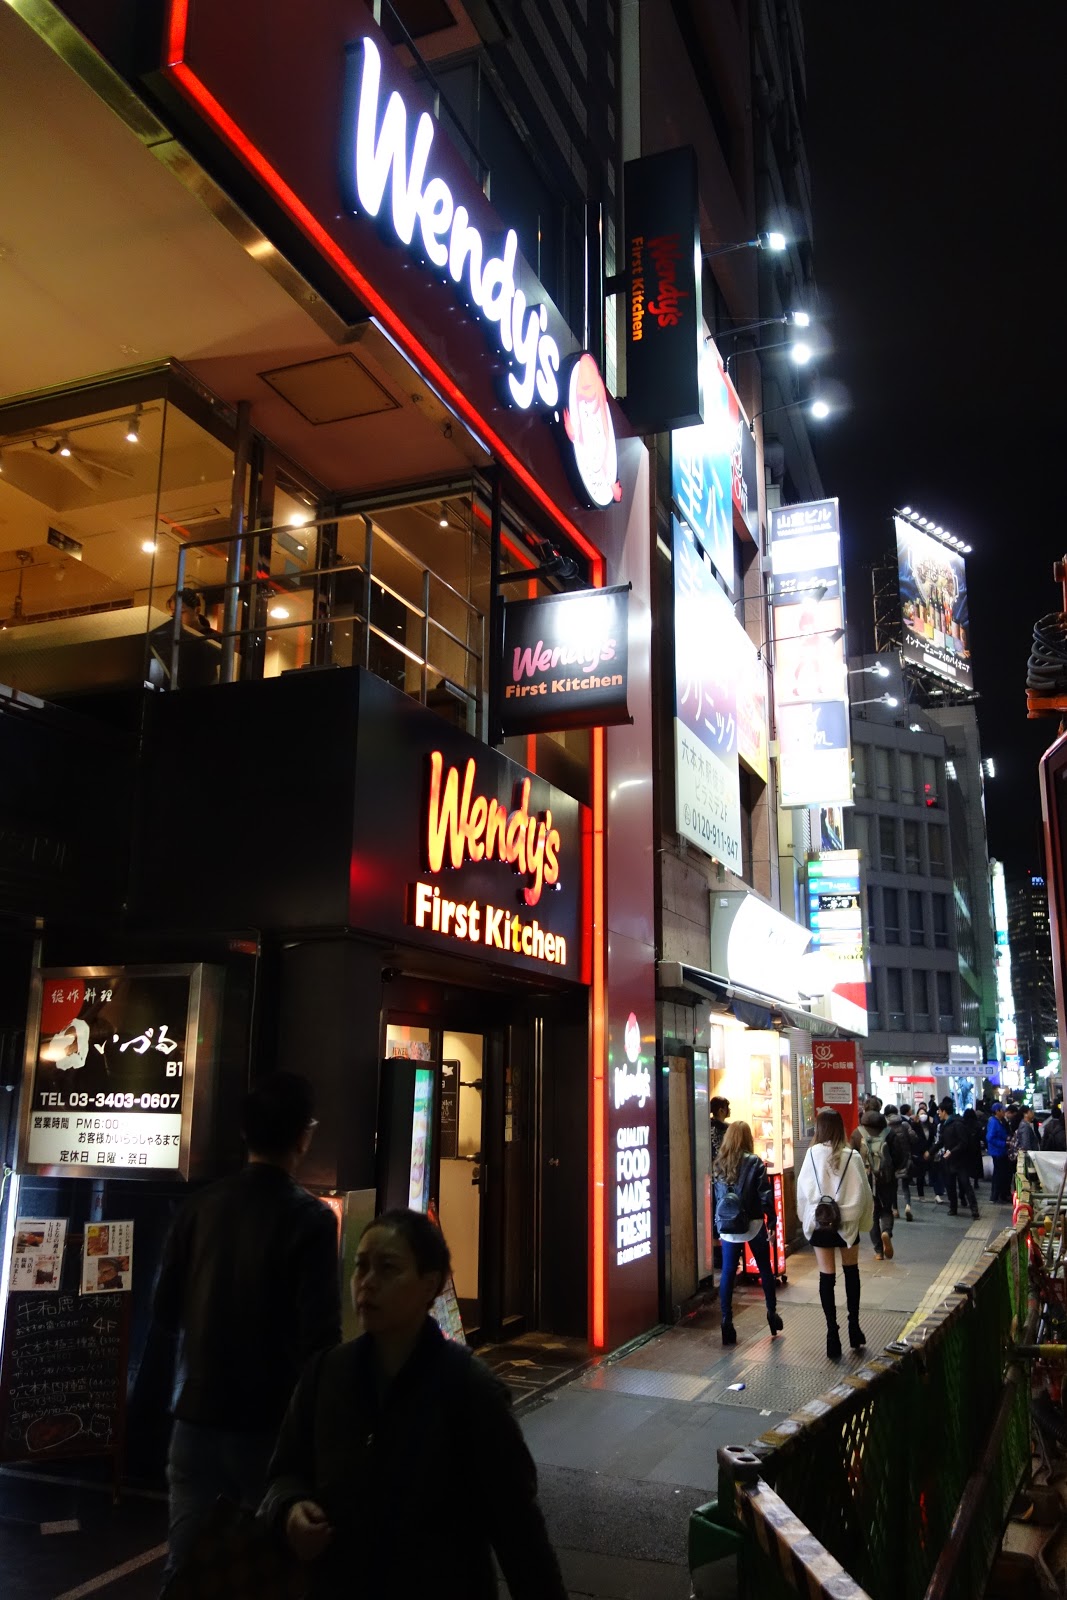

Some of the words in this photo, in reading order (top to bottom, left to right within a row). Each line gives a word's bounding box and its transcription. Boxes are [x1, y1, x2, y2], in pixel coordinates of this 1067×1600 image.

[356, 36, 561, 409] Wendy's
[632, 236, 644, 275] First
[648, 233, 689, 328] Wendy's
[632, 278, 645, 341] Kitchen
[505, 682, 548, 699] First
[551, 674, 623, 693] Kitchen
[427, 750, 561, 906] Wendy's
[692, 808, 739, 861] 0120-911-847
[415, 881, 481, 942] First
[484, 904, 567, 966] Kitchen
[165, 1061, 183, 1077] B1
[40, 1092, 66, 1106] TEL
[69, 1092, 180, 1109] 03-3403-0607
[34, 1116, 70, 1129] 営業時間
[616, 1125, 650, 1150] QUALITY
[59, 1150, 90, 1163] 定休日
[616, 1148, 650, 1182] FOOD
[616, 1179, 651, 1216] MADE
[616, 1211, 651, 1249] FRESH
[92, 1316, 118, 1334] 4F
